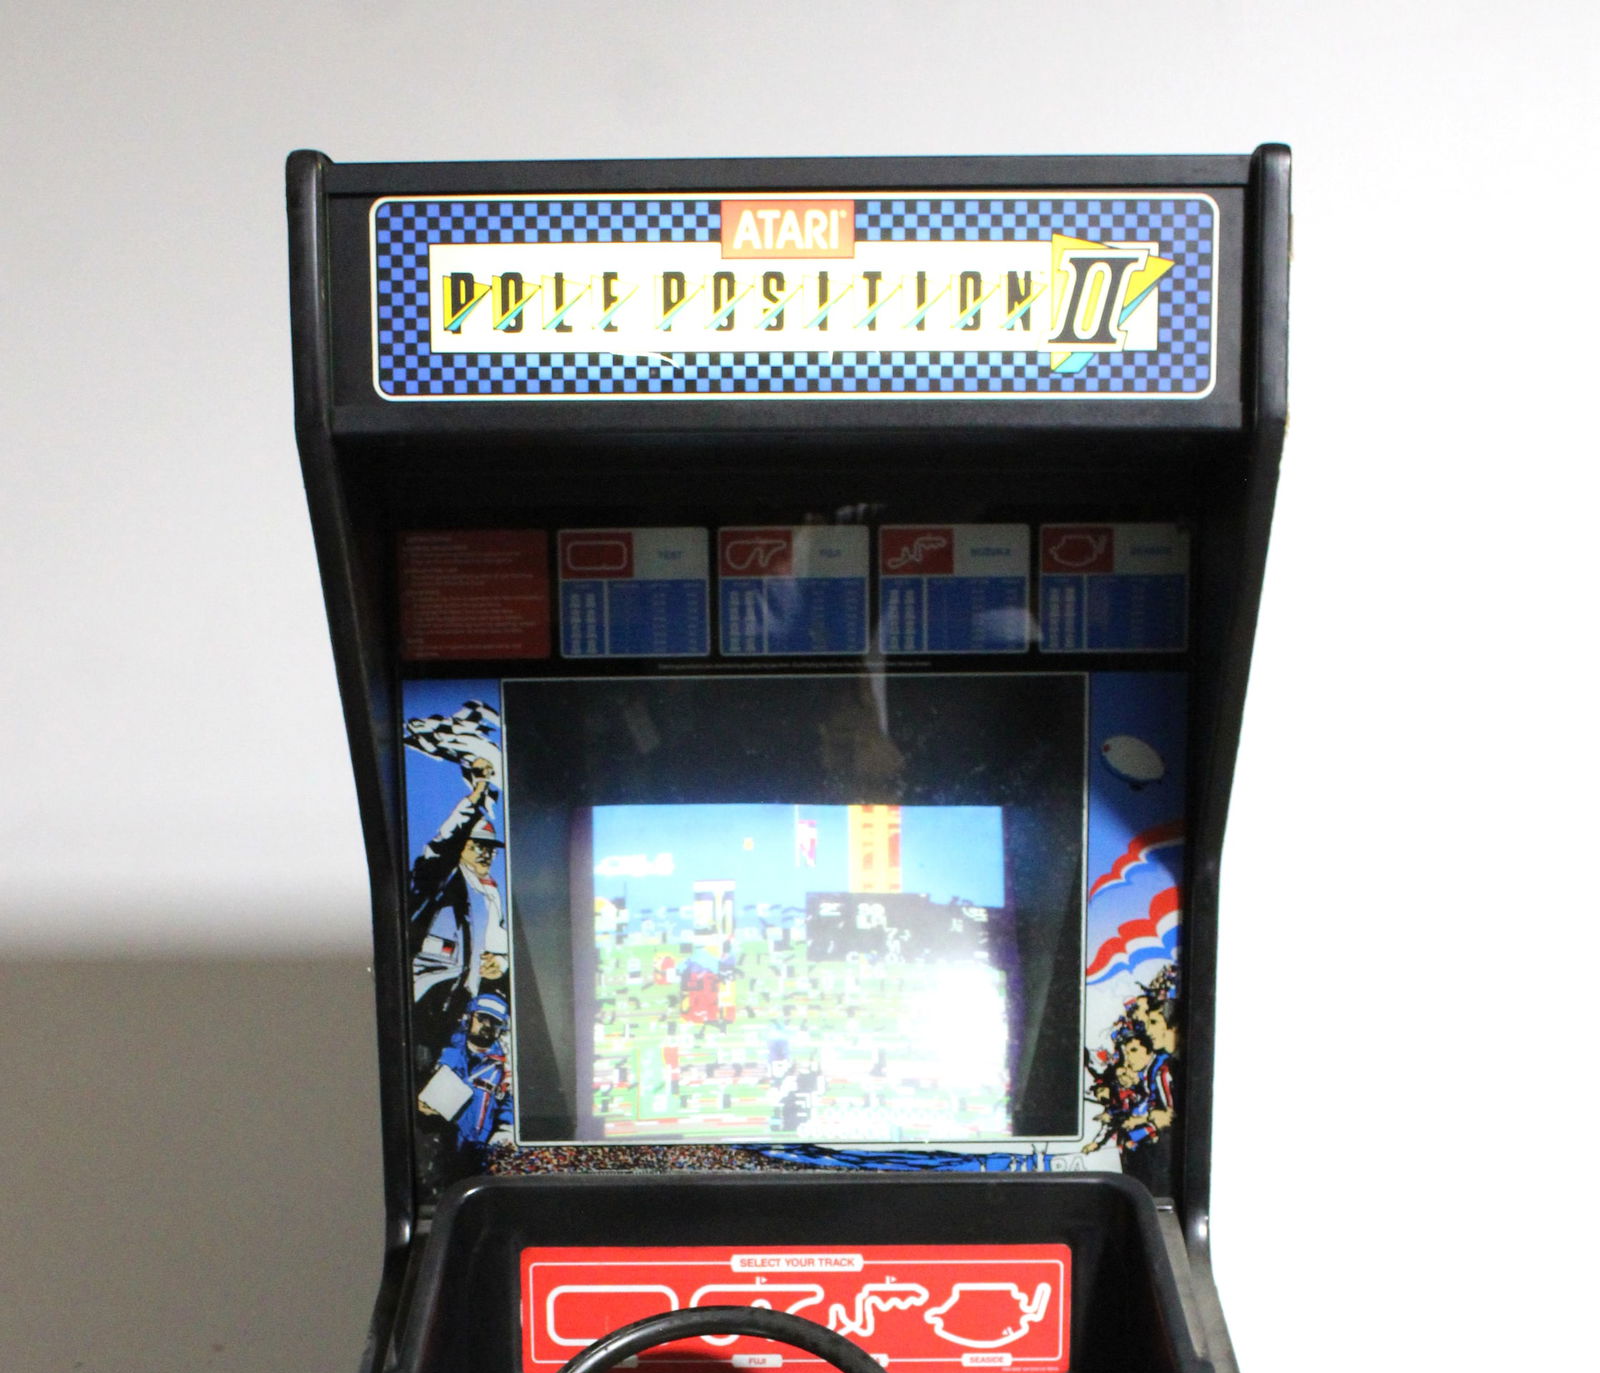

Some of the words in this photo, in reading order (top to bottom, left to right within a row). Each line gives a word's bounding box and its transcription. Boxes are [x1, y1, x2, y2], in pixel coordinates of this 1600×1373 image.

[449, 271, 620, 334] POLE
[661, 270, 1033, 333] POSITION
[1047, 256, 1141, 345] II
[739, 1257, 781, 1268] SELECT
[784, 1257, 816, 1268] YOUR
[817, 1256, 856, 1268] TRACK
[968, 1355, 1005, 1364] SEASIDE
